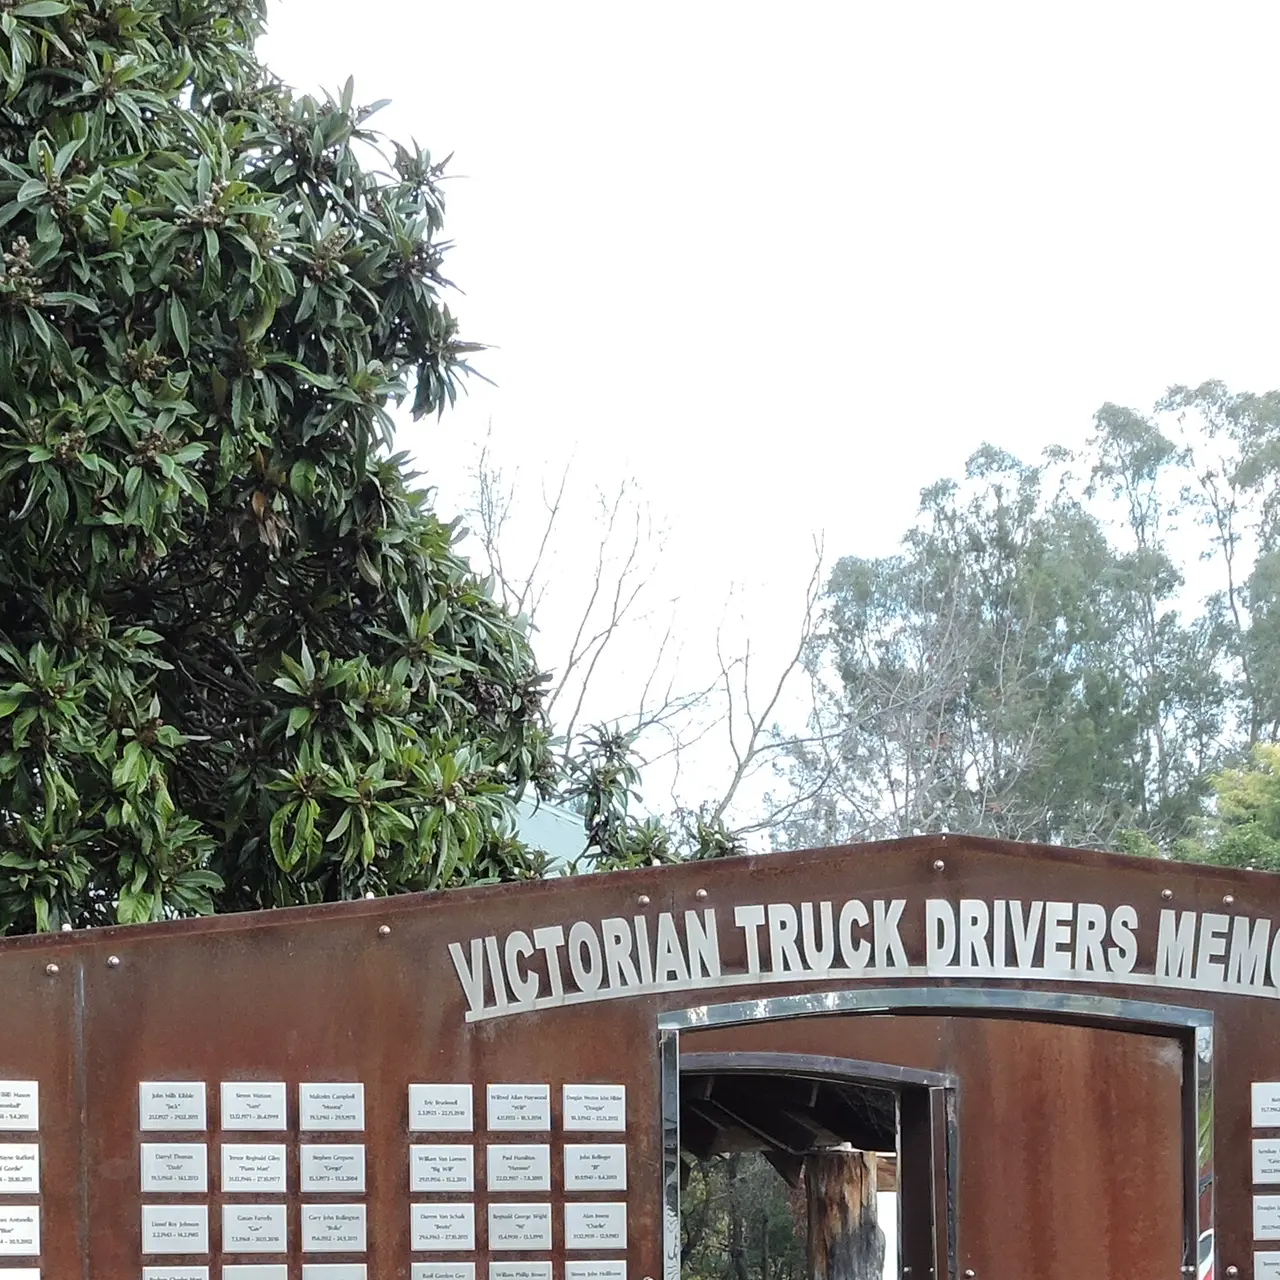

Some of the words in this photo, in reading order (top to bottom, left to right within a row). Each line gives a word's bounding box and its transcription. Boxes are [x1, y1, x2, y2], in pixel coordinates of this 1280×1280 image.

[448, 909, 721, 1020] VICTORIAN
[735, 900, 909, 975] TRUCK
[926, 900, 1138, 975] DRIVERS
